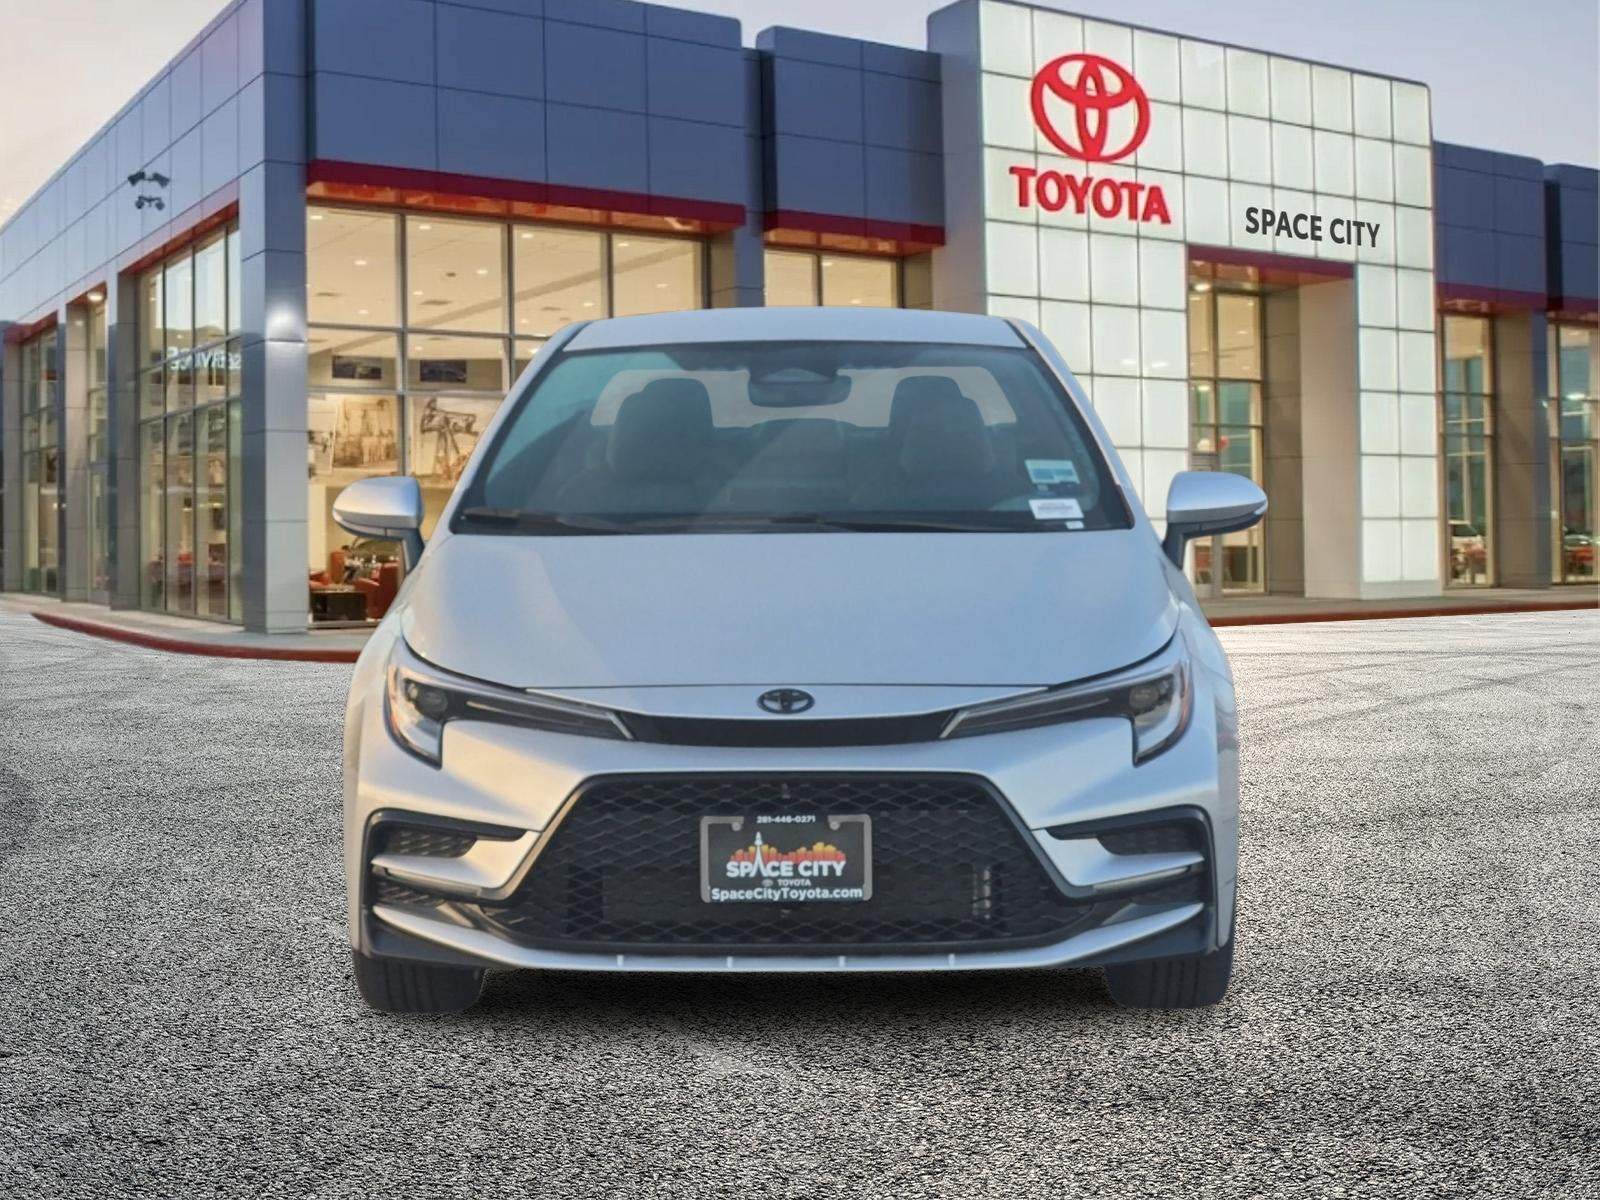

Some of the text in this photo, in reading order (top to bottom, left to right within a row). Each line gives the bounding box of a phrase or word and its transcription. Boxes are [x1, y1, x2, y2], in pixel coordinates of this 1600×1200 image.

[1009, 166, 1172, 225] TOYOTA
[1245, 206, 1381, 248] SPACE CITY
[726, 861, 847, 877] SPACE CITY
[777, 879, 812, 887] TOYOTA
[711, 887, 863, 902] SpaceCityToyota.com
